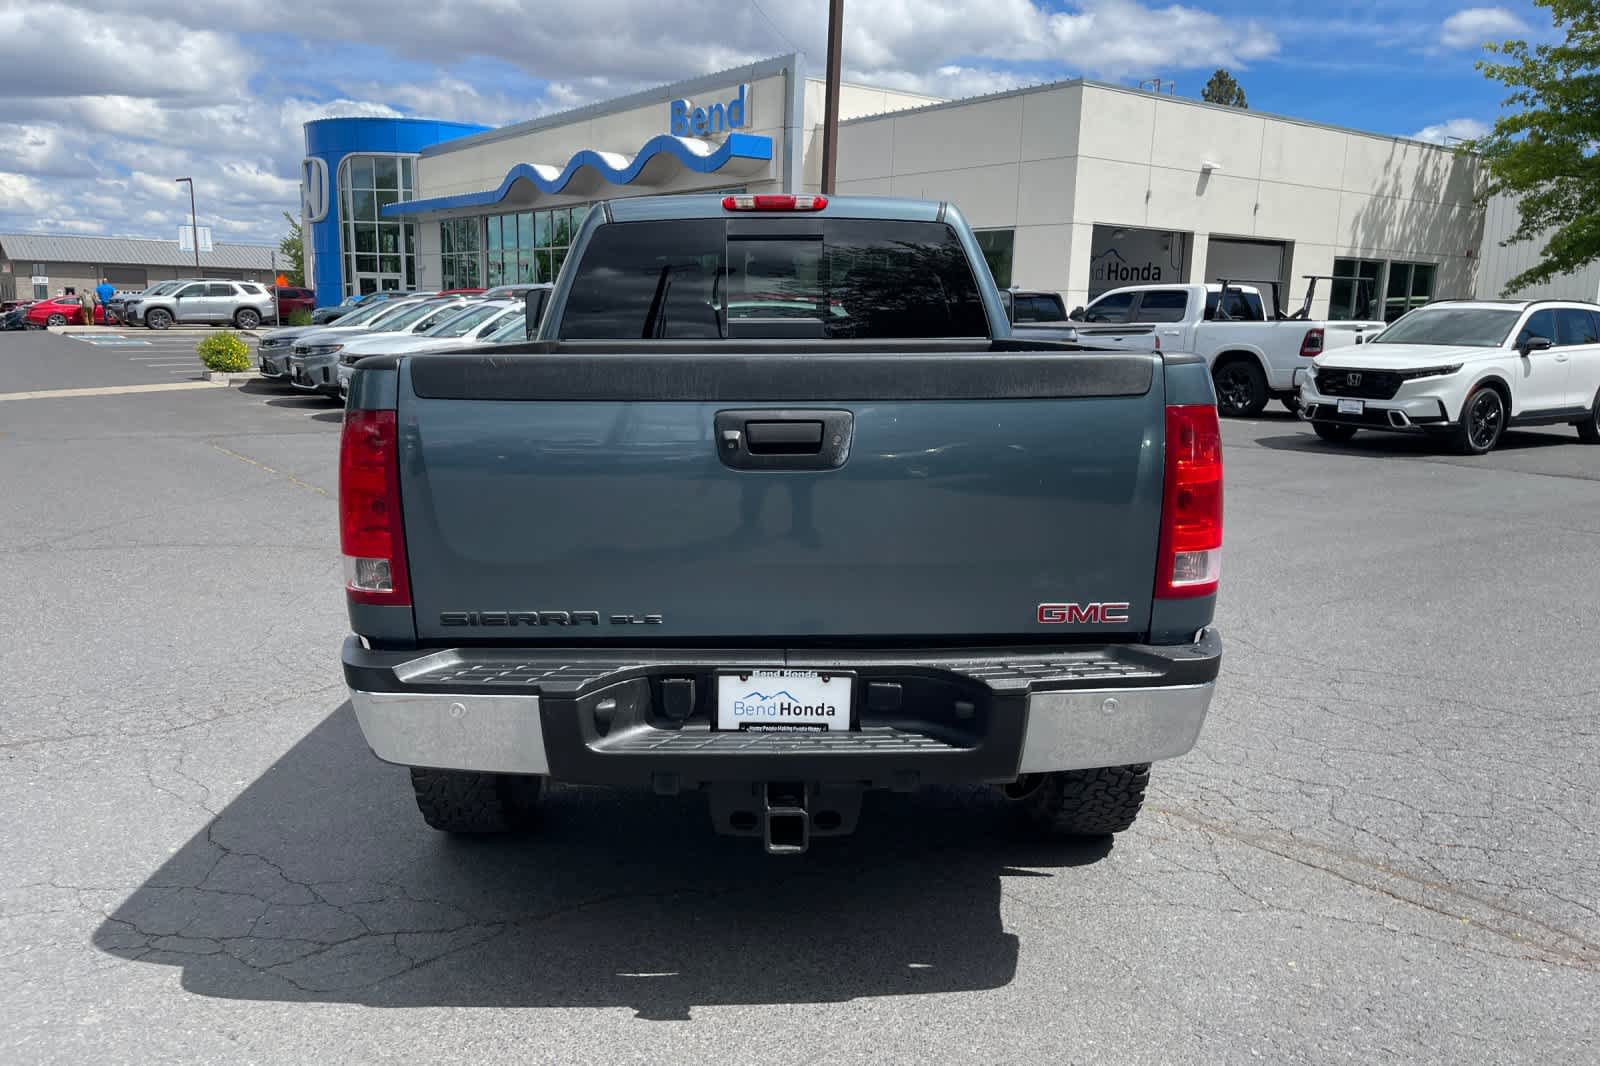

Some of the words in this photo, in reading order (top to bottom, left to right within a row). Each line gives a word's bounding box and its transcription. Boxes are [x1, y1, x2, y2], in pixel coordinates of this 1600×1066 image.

[670, 84, 746, 137] Bend
[1107, 262, 1161, 281] Honda
[440, 611, 600, 626] SIERRA
[609, 614, 663, 625] SLE
[1037, 602, 1130, 624] GMC
[752, 669, 780, 679] Bend
[783, 669, 818, 679] Honda
[734, 701, 776, 716] Bend
[780, 702, 836, 716] Honda
